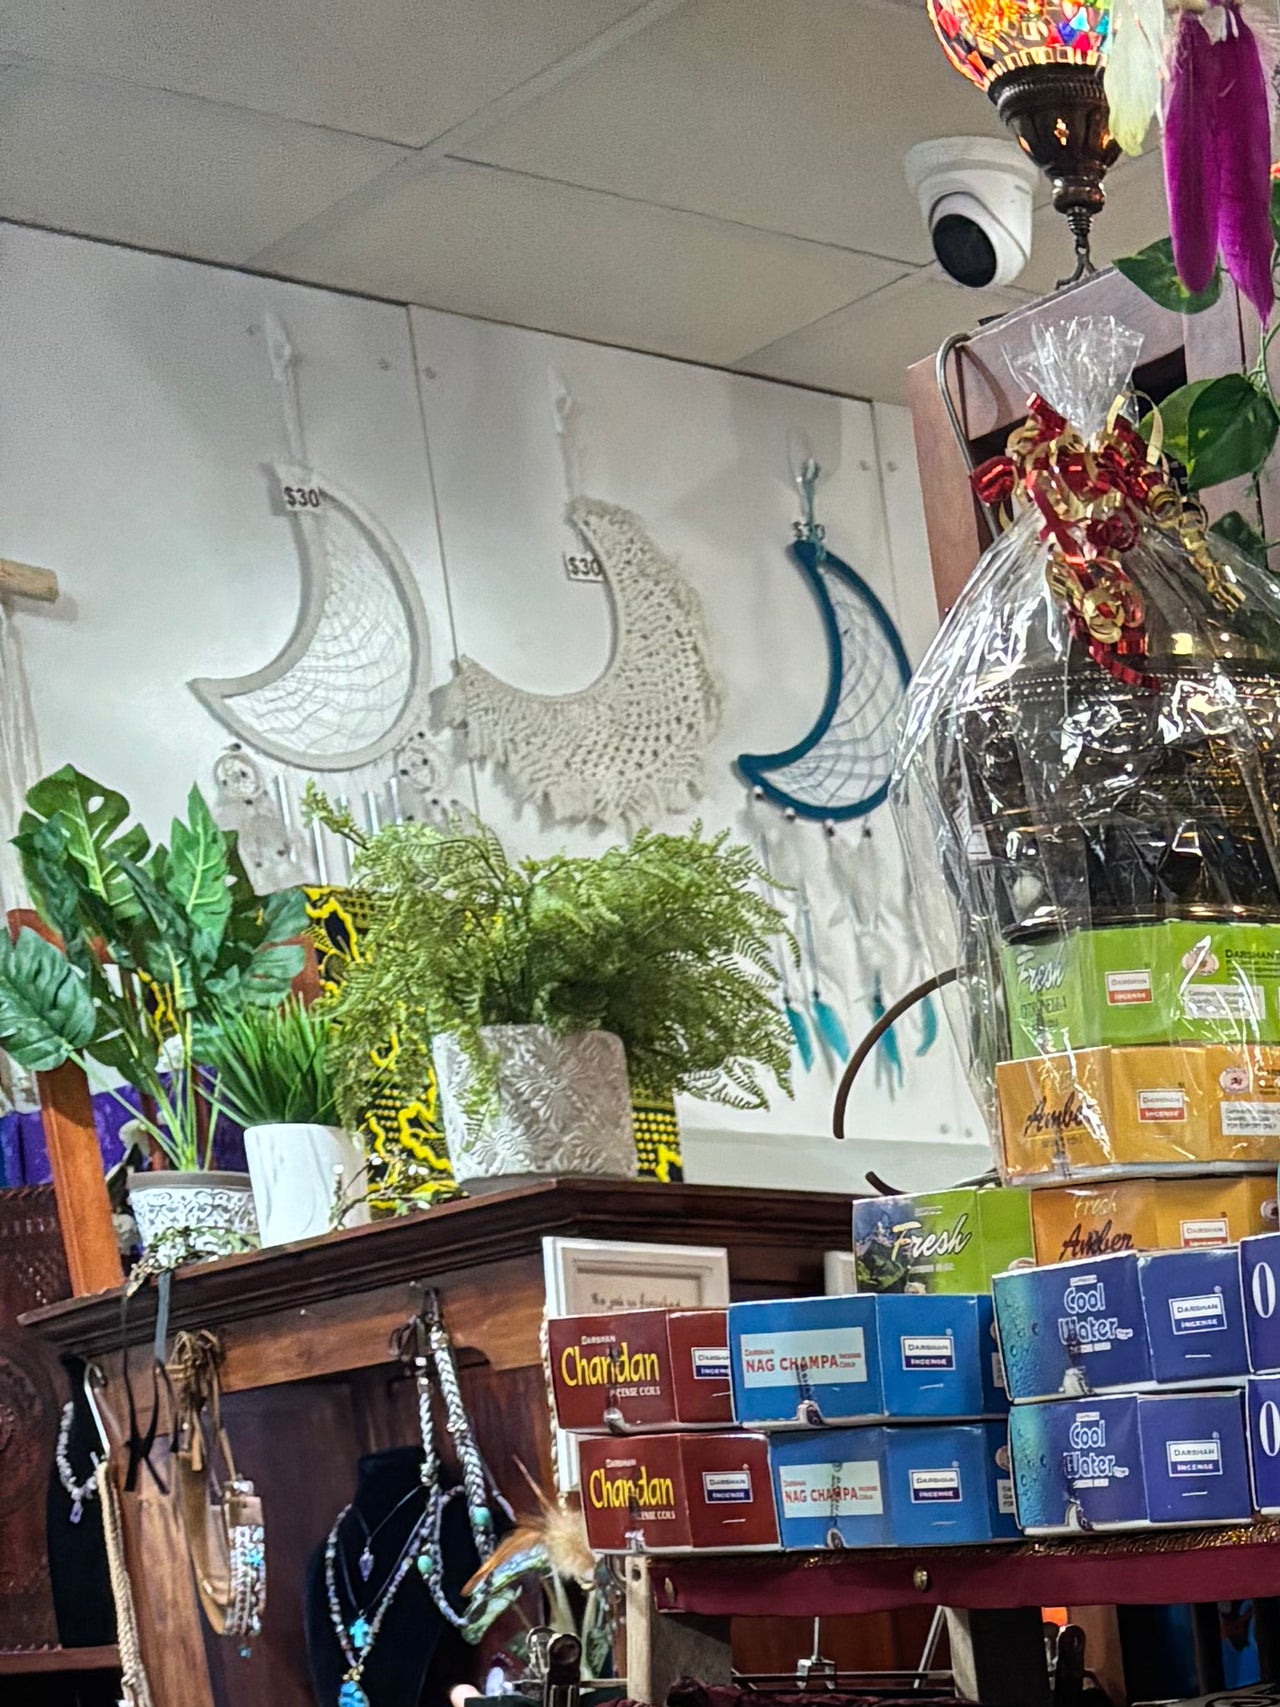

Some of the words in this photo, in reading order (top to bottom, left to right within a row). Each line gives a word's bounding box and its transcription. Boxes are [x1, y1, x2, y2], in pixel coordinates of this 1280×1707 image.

[1225, 948, 1274, 961] DARSHAN
[892, 1213, 972, 1261] Fresh
[1064, 1282, 1105, 1314] Cool
[1176, 1303, 1219, 1314] DARSHAN
[1058, 1315, 1118, 1345] Water
[561, 1342, 660, 1387] Chandan
[745, 1357, 775, 1373] NAG
[779, 1354, 840, 1372] CHAMPA
[1070, 1420, 1105, 1449] Cool
[589, 1465, 675, 1509] Chandan
[784, 1489, 807, 1504] NAG
